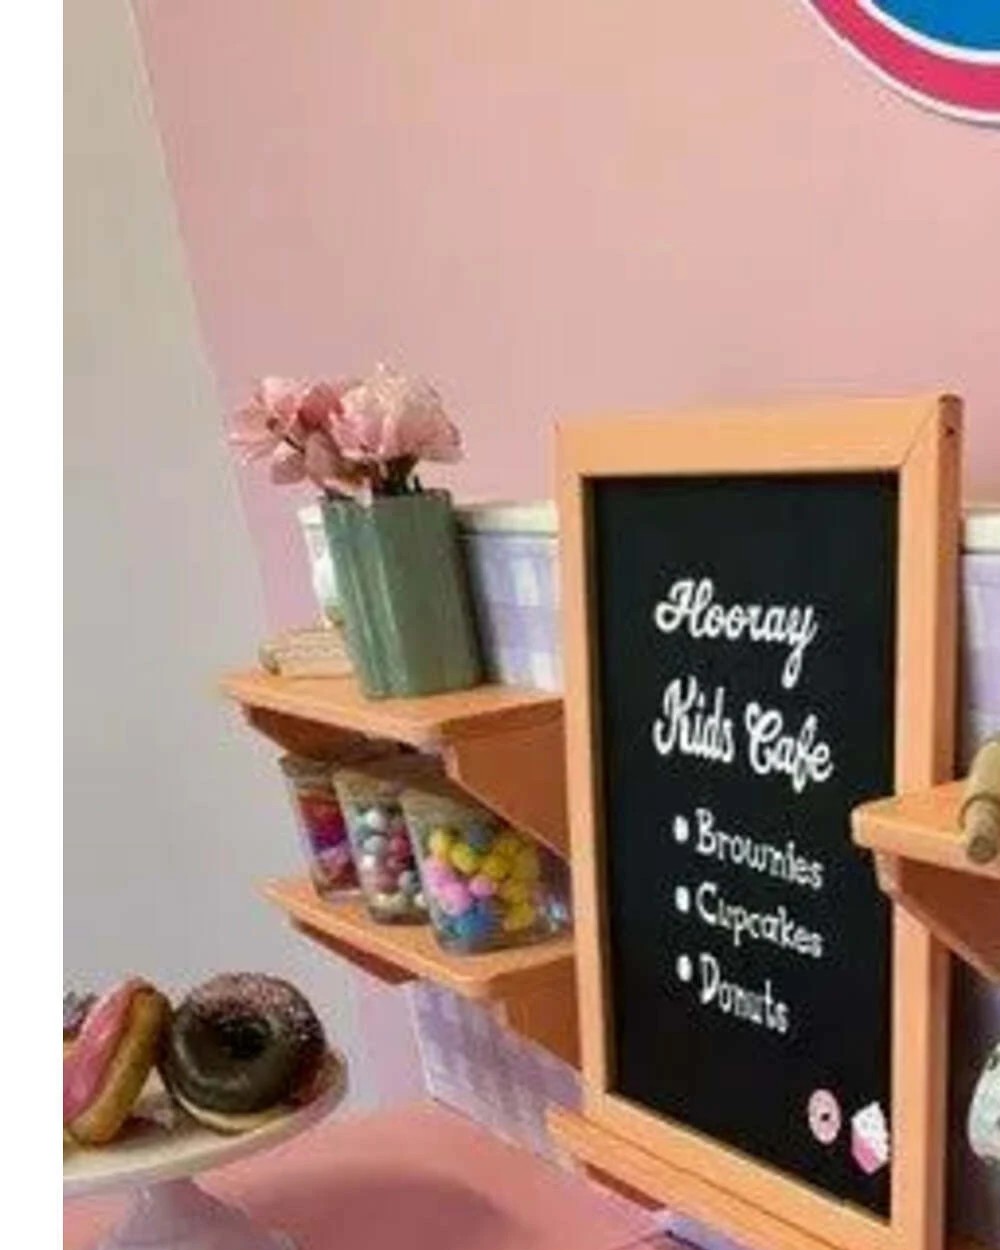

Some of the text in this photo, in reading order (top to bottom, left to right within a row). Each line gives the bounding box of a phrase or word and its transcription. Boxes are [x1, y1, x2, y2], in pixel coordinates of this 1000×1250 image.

[654, 577, 819, 689] Hooray
[653, 675, 835, 793] Kids Cafe
[695, 807, 823, 890] Brownies
[695, 881, 823, 958] Cupcakes
[699, 952, 788, 1033] Donuts
